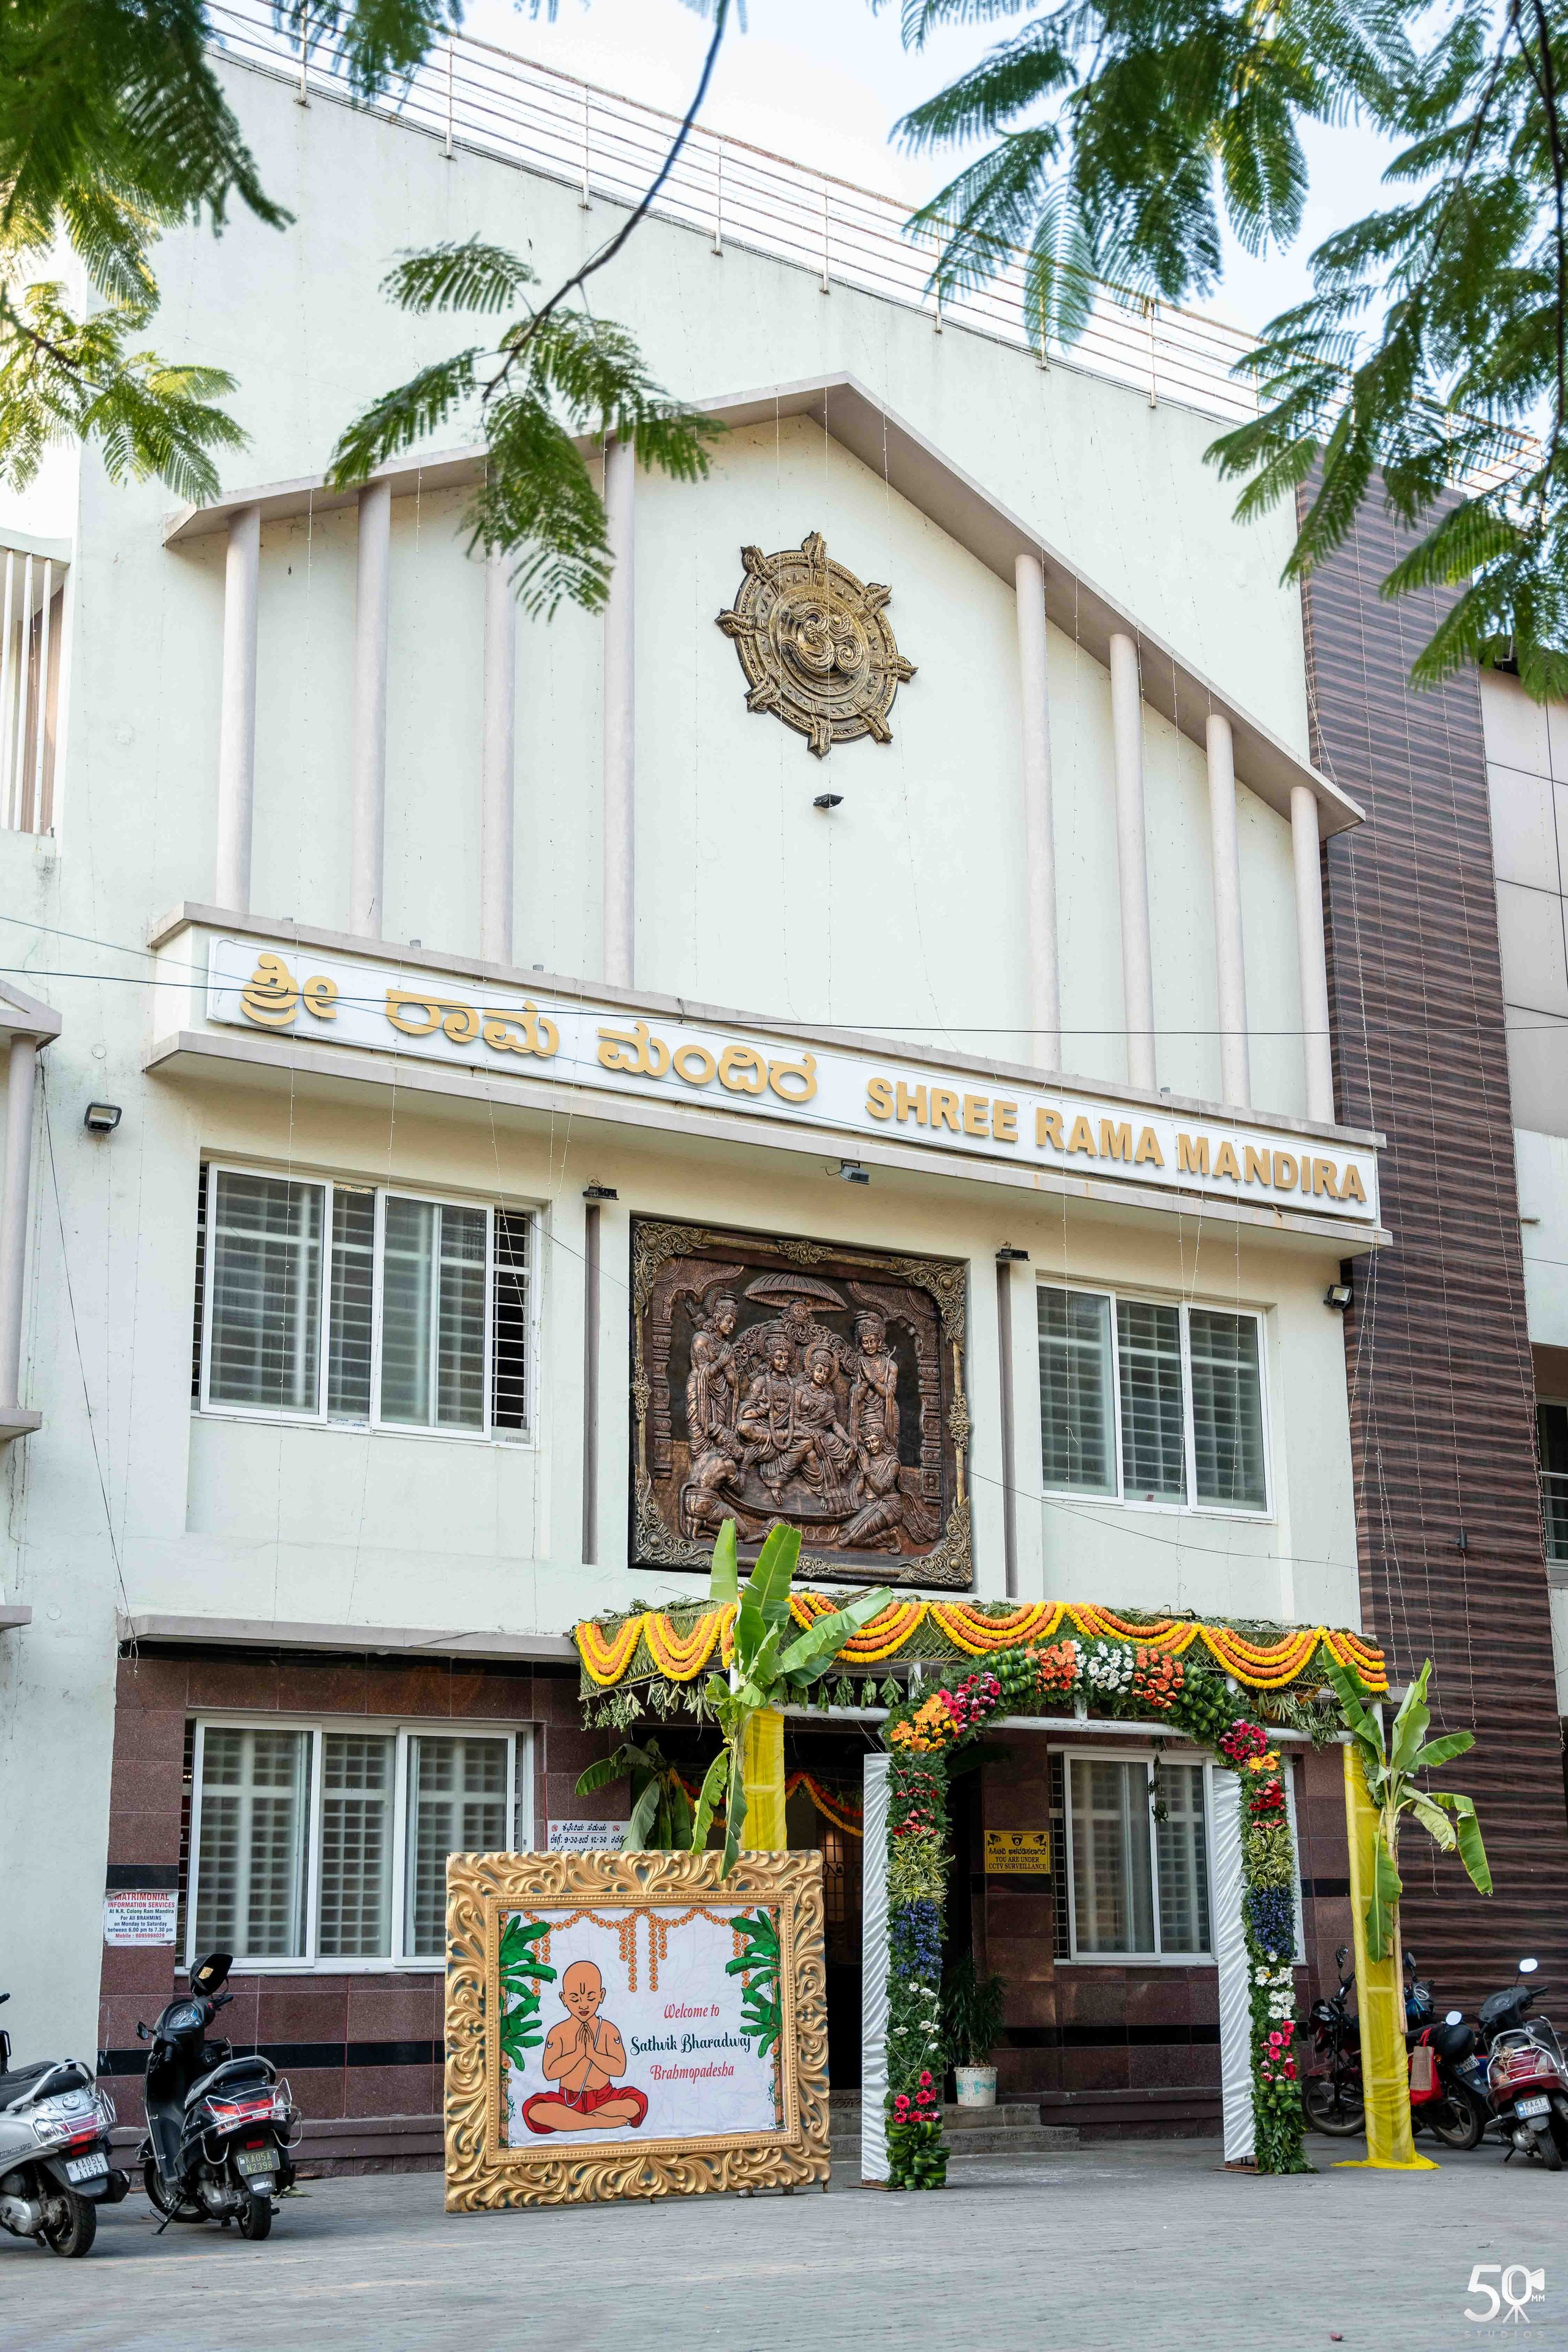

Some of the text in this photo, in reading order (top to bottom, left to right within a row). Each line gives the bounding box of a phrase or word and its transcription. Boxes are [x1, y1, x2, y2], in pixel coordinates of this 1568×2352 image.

[239, 953, 818, 1102] ಶ್ರೀ ರಾಮ ಮಂದಿರ
[865, 1077, 1367, 1202] SHREE RAMA MANDIRA
[663, 2003, 720, 2019] Welcome to
[630, 2032, 751, 2056] Sathvik Bharadwaj
[650, 2062, 734, 2084] Brahmopadesha
[1525, 2099, 1543, 2109] KA41
[75, 2155, 102, 2169] KA05L
[245, 2152, 271, 2164] KA05A
[79, 2164, 105, 2179] A1521
[246, 2162, 273, 2173] N2398
